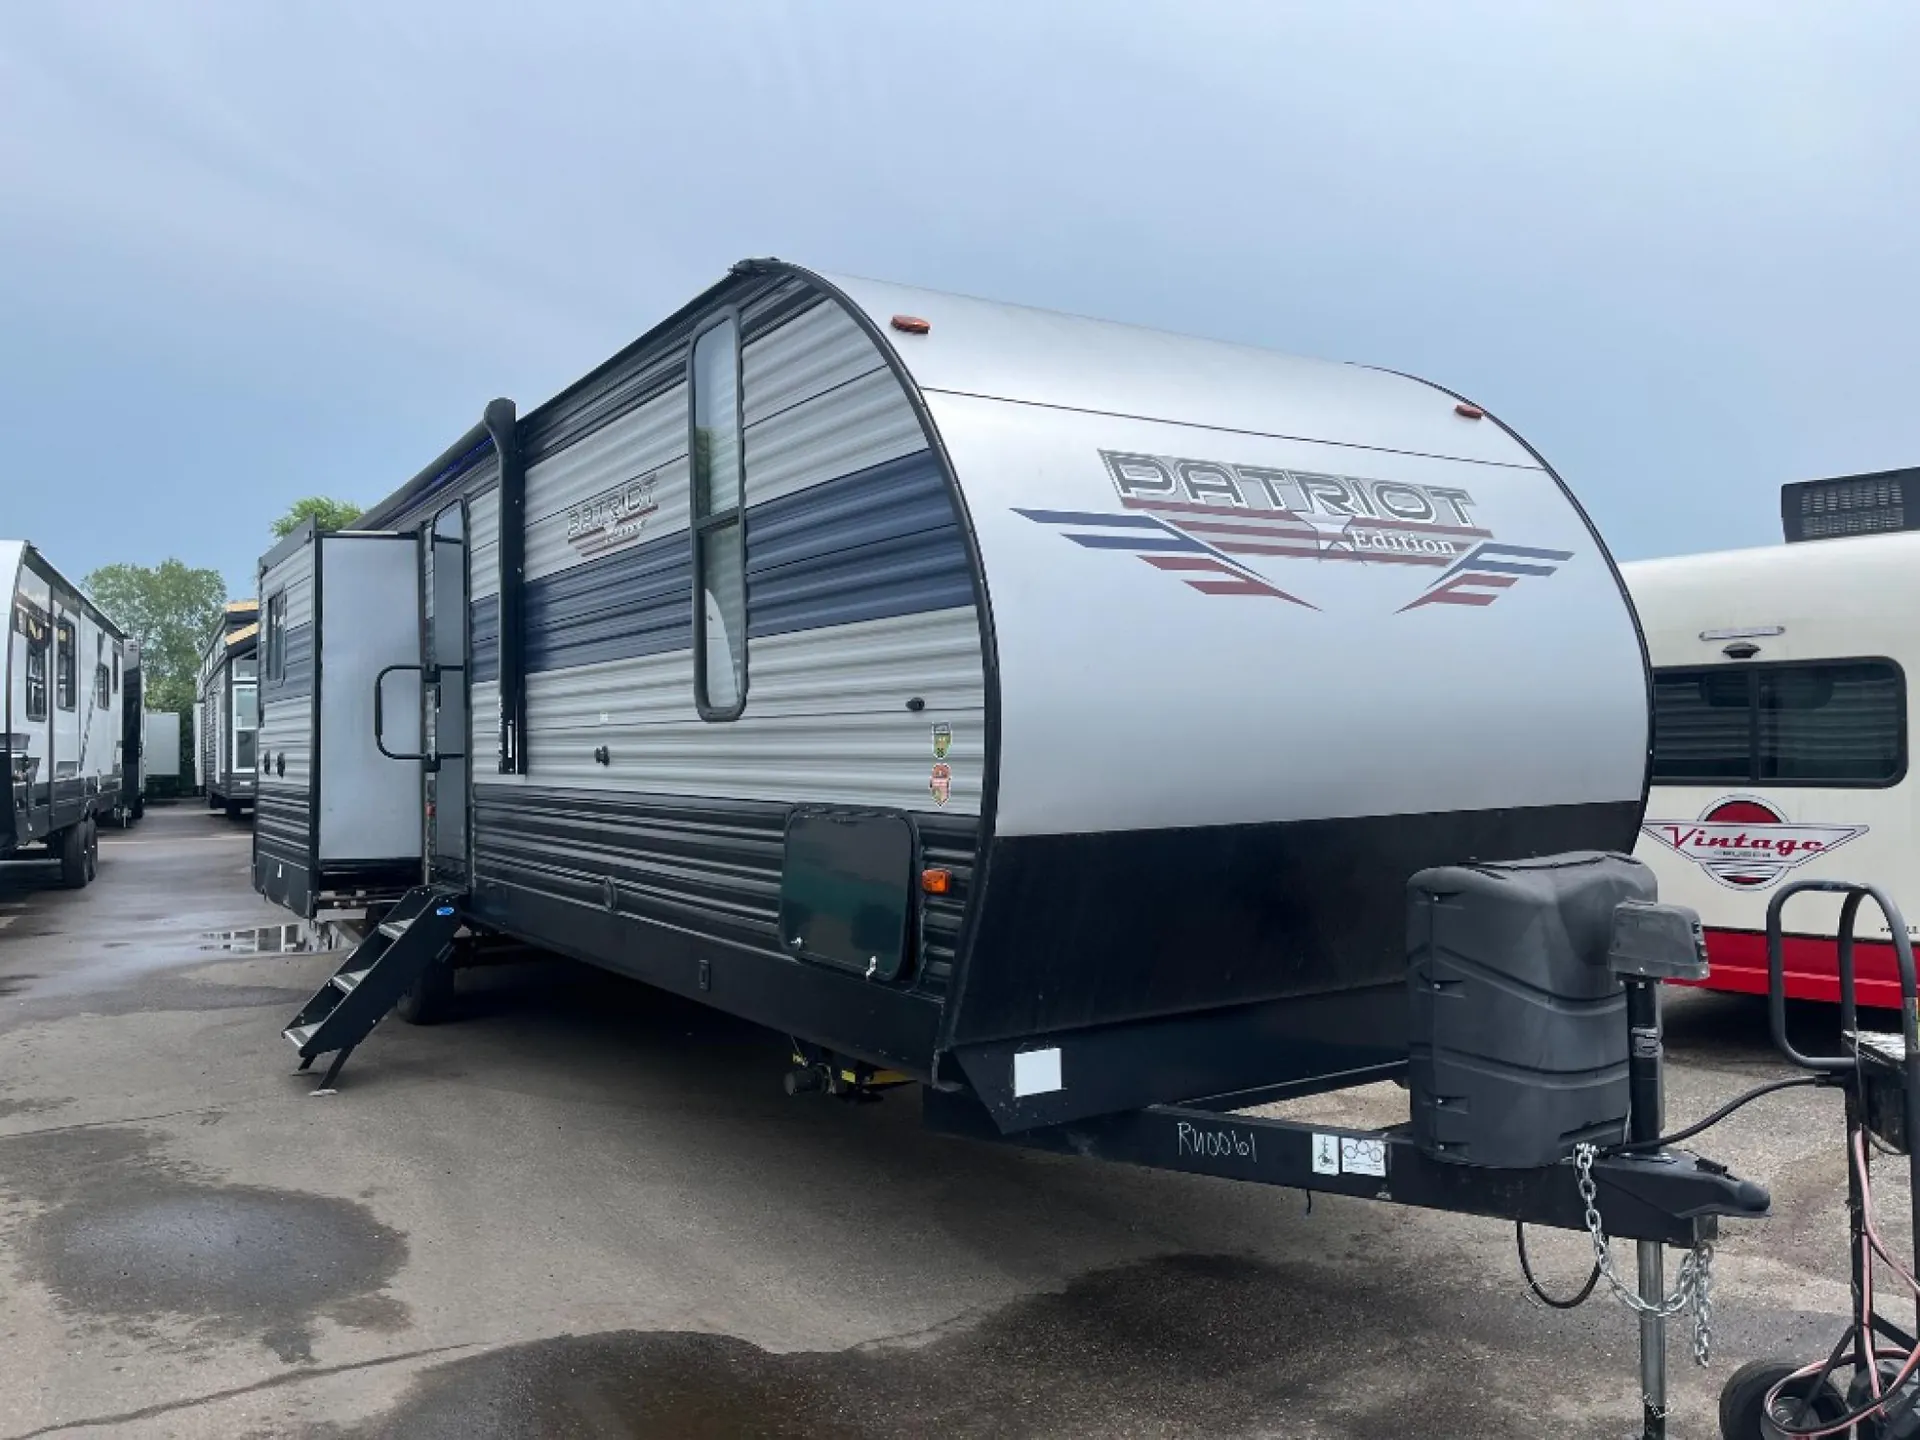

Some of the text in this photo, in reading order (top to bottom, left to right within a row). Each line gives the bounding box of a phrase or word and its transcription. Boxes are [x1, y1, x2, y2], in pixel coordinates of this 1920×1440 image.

[1098, 449, 1476, 529] PATRIOT
[1351, 530, 1456, 555] Edition
[1664, 826, 1825, 857] Vintage
